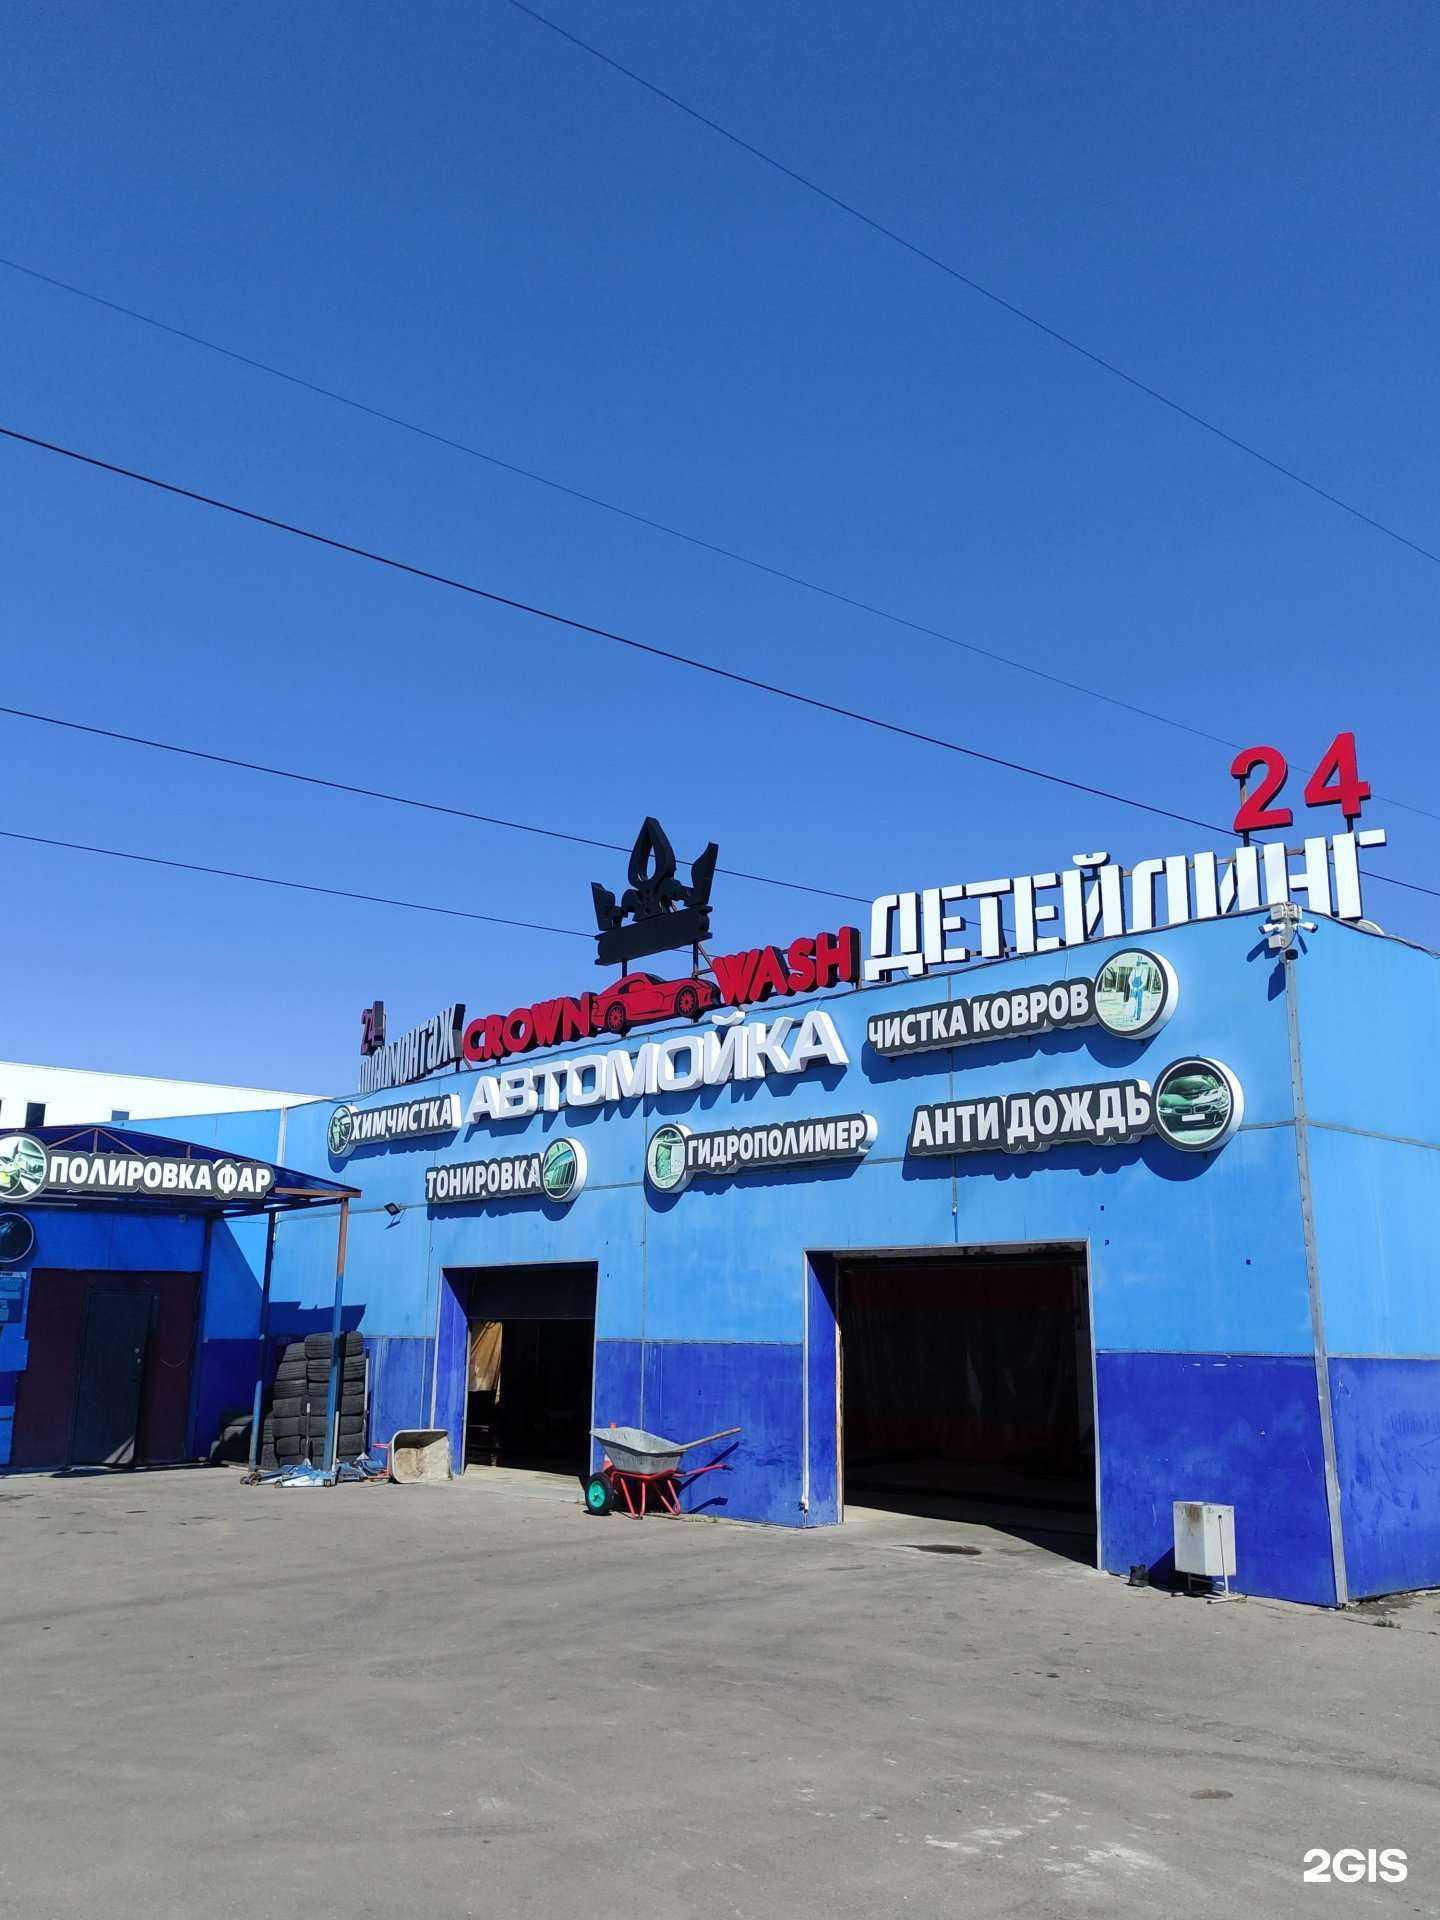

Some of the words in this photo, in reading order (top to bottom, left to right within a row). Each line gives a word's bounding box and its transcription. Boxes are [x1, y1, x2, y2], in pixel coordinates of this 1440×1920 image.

[864, 829, 1387, 983] ДЕТЕЙЛИНГ
[462, 992, 598, 1063] CROWN
[712, 926, 861, 1005] WASH
[868, 1005, 968, 1049] ЧИСТКА
[972, 983, 1089, 1033] КОВРОВ
[464, 1010, 849, 1124] АВТОМОЙКА
[350, 1097, 453, 1140] ХИМЧИСТКА
[687, 1120, 865, 1168] ГИДРОПОЛИМЕР
[912, 1101, 999, 1147] АНТИ
[1007, 1085, 1150, 1145] ДОЖДЬ
[49, 1156, 212, 1190] ПОЛИРОВКА
[217, 1163, 271, 1194] ФАР
[426, 1158, 541, 1198] ТОНИРОВКА
